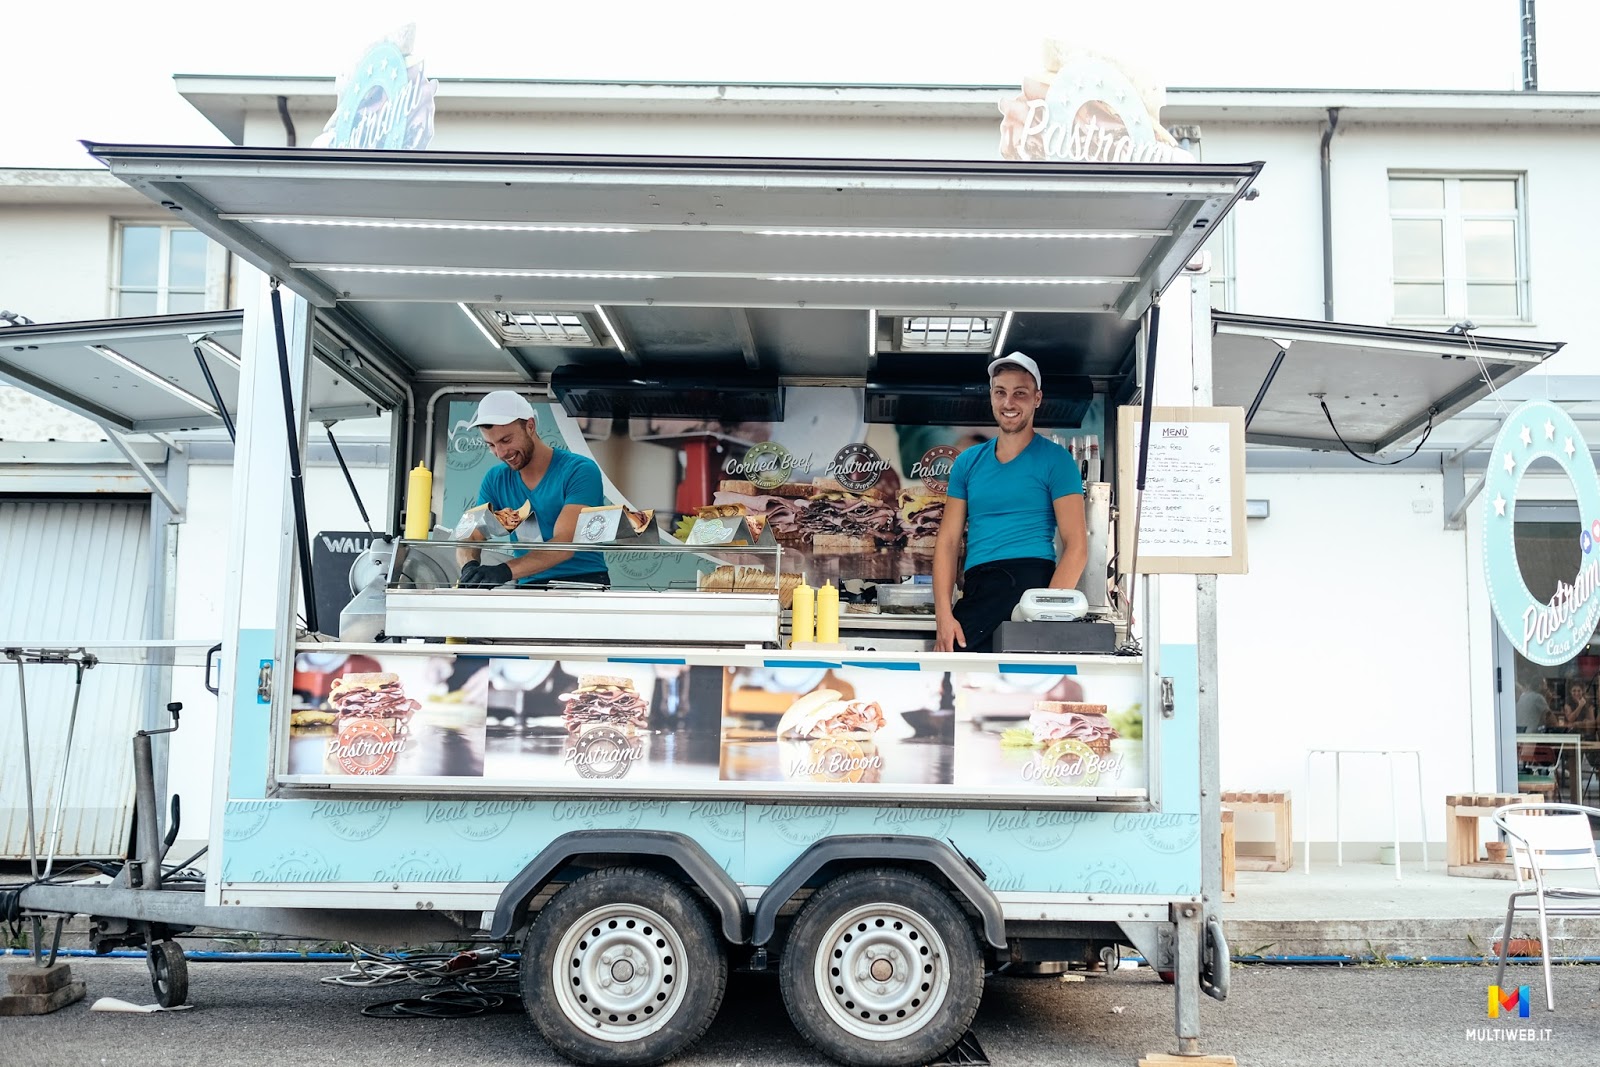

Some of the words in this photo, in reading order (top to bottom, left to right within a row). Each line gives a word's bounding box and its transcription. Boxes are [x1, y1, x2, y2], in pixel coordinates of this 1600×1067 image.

[454, 437, 485, 454] CAS
[726, 455, 778, 475] Corned
[780, 452, 813, 474] Beef
[824, 458, 891, 476] Pastrami
[1546, 638, 1571, 656] Casa
[326, 737, 407, 760] Pastrami
[564, 744, 643, 767] Pastrami
[341, 758, 357, 773] Red
[788, 756, 825, 778] Veal
[828, 753, 882, 773] Bacon
[1021, 757, 1083, 781] Corned
[1086, 752, 1124, 779] Beef
[424, 802, 468, 825] Veal
[473, 801, 536, 818] Bacon
[986, 812, 1030, 833] Veal
